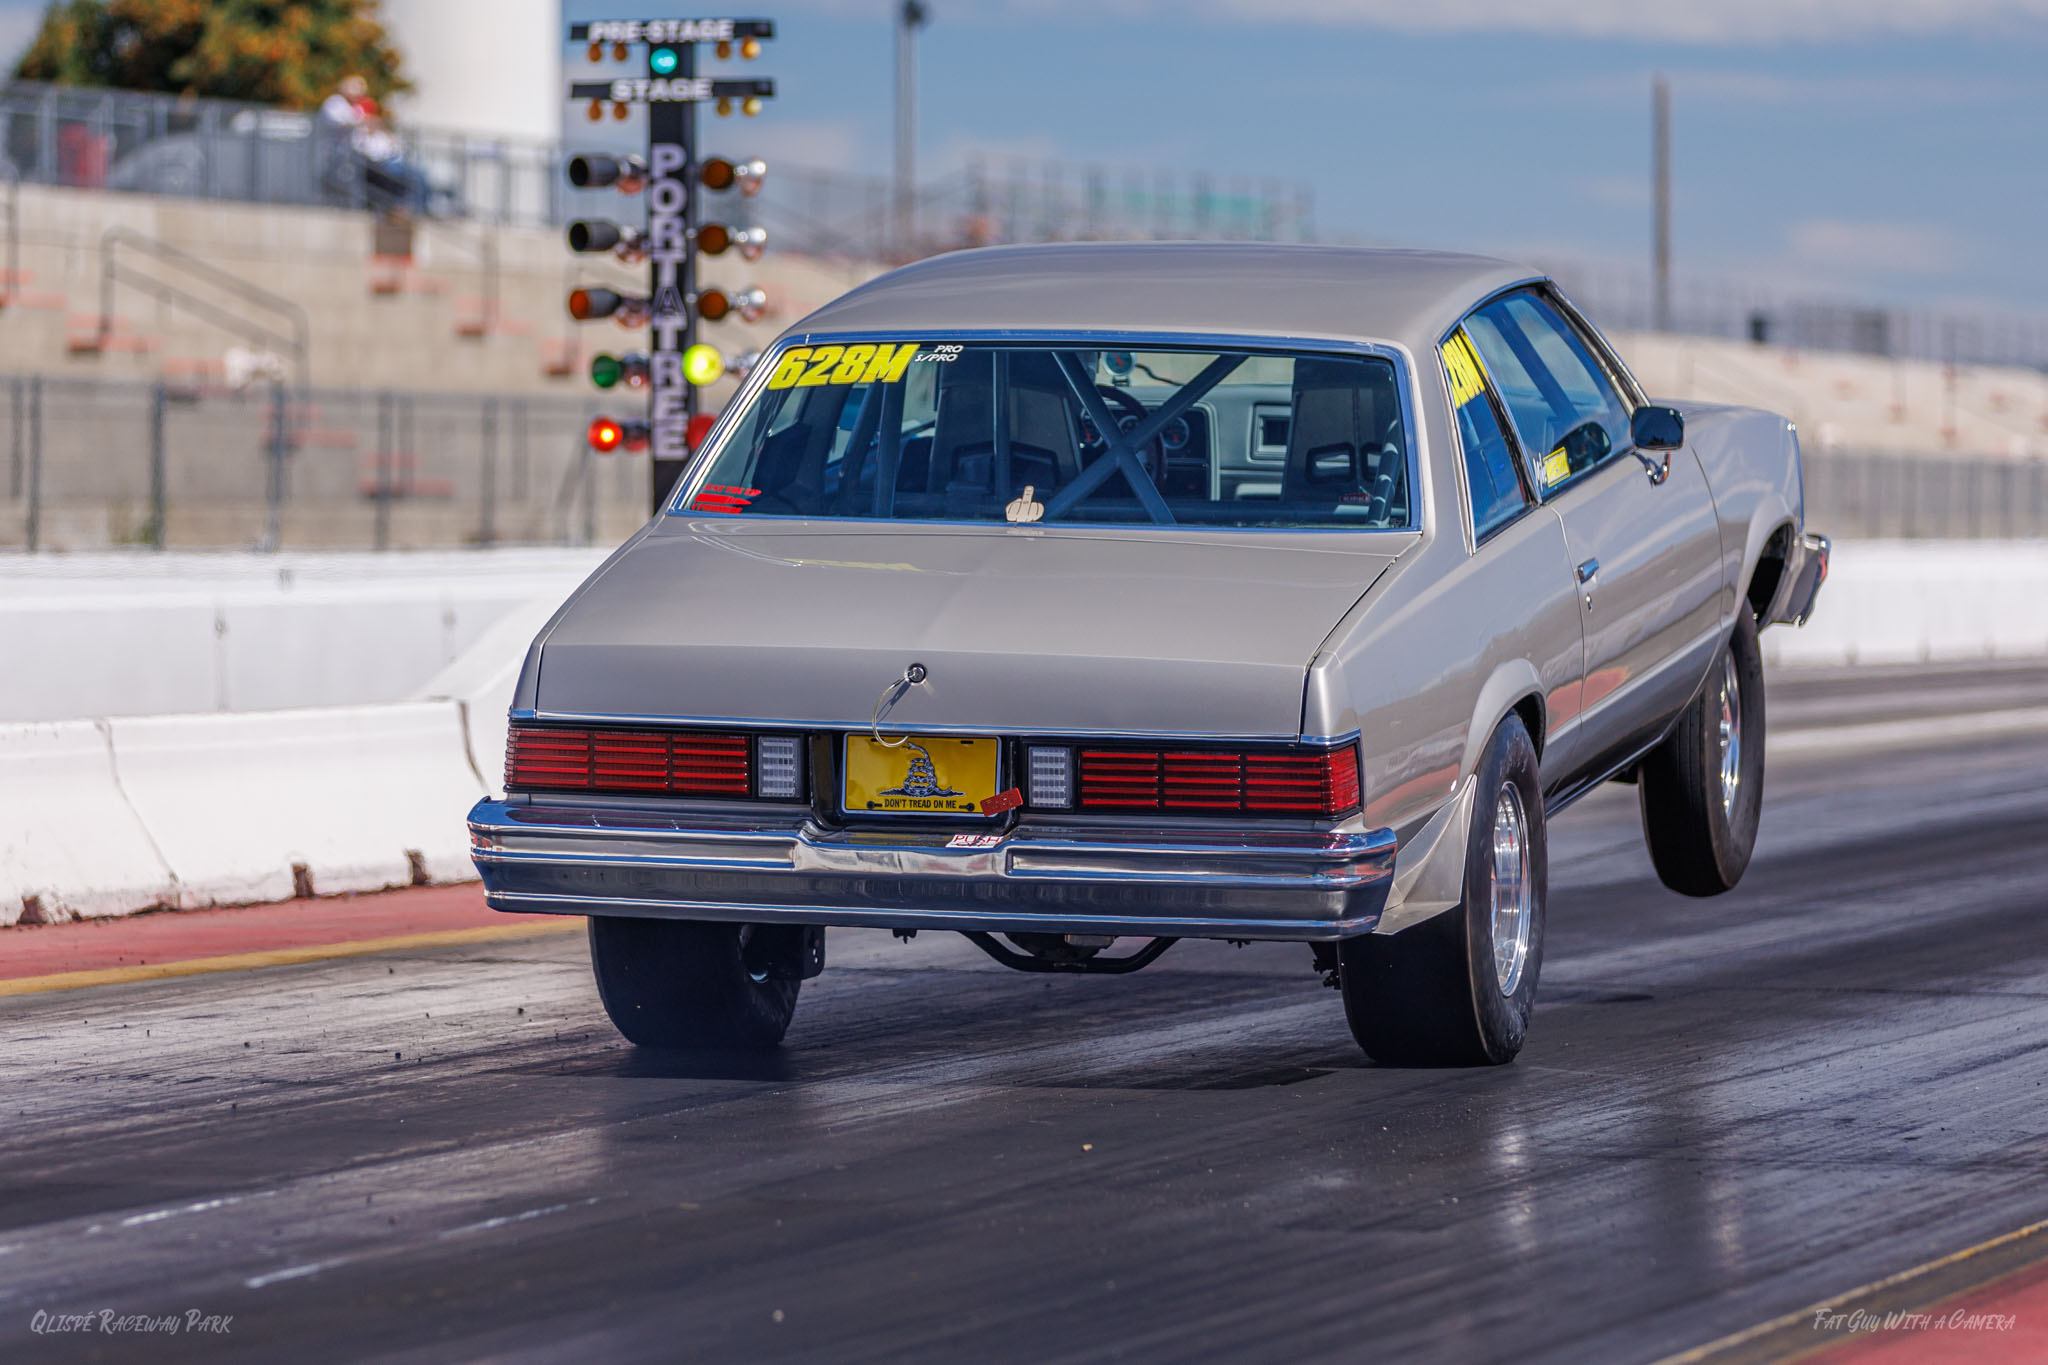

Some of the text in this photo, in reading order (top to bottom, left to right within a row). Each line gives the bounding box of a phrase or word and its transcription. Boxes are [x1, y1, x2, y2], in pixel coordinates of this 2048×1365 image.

[588, 19, 734, 42] PRE-STAGE
[611, 78, 713, 101] STAGE
[934, 345, 964, 353] PRO
[914, 353, 959, 362] S/PRO
[767, 344, 920, 390] 628M
[884, 799, 957, 809] DON'T TREAD ON ME
